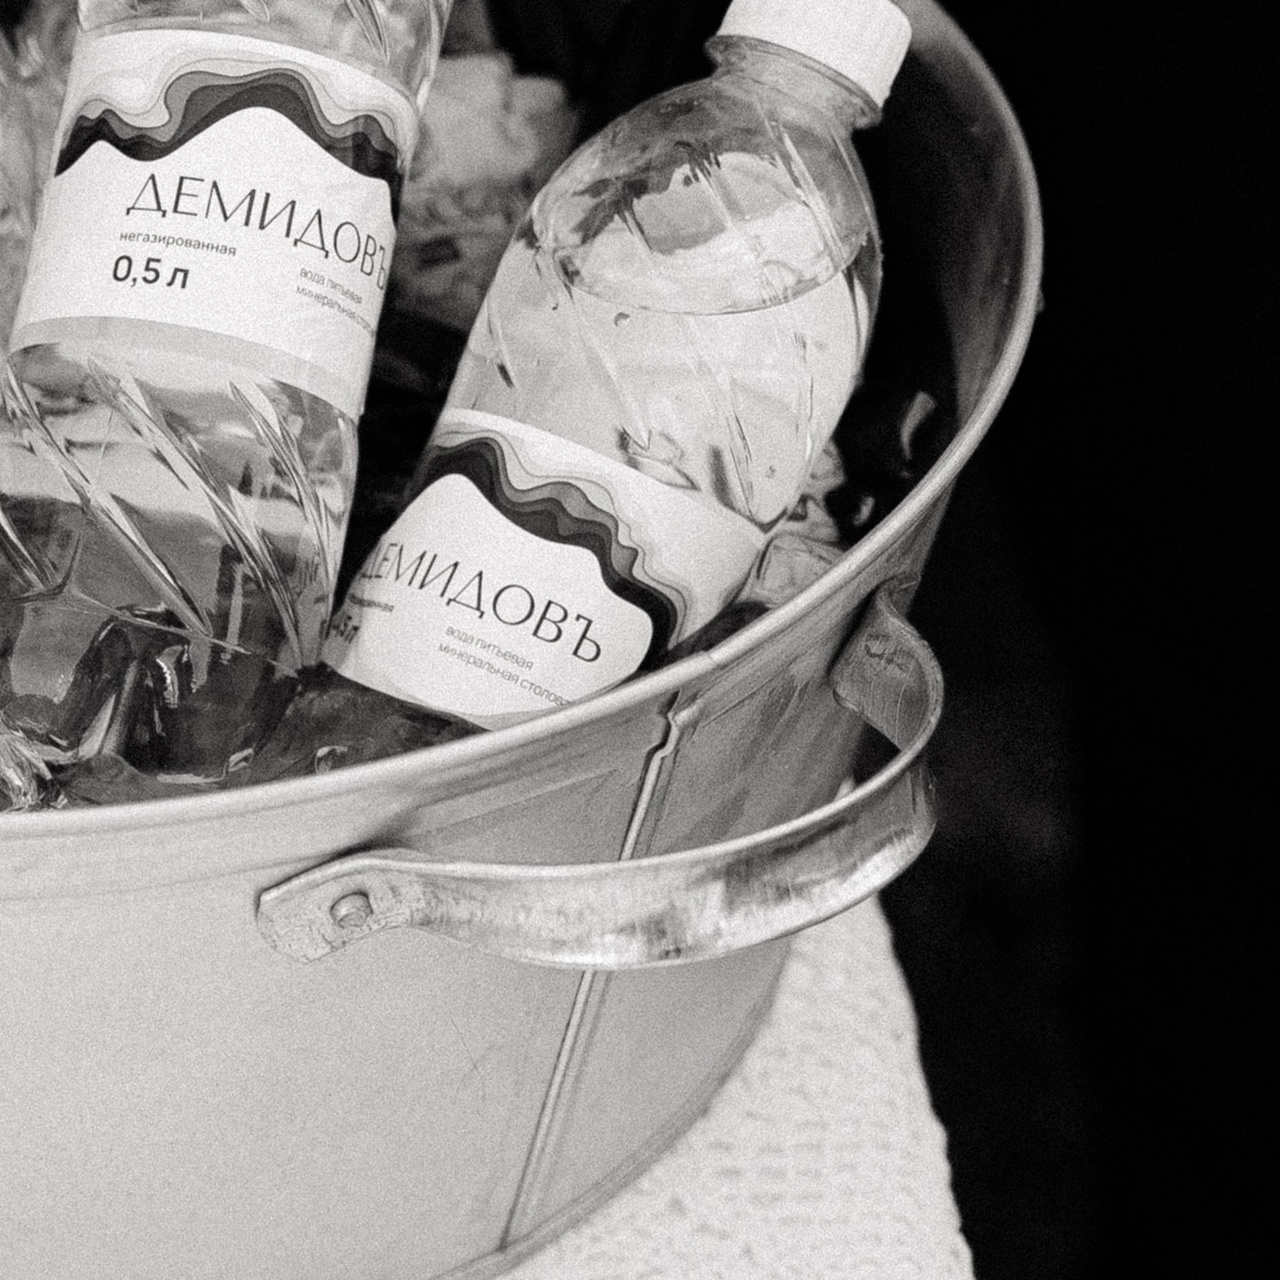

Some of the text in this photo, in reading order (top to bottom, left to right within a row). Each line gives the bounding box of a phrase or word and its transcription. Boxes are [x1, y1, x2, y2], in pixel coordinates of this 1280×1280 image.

[119, 231, 237, 257] негазированная
[125, 173, 387, 291] ДЕМИДОВЪ
[112, 255, 190, 289] 0,5 л
[438, 642, 519, 686] минеральная
[445, 625, 534, 672] вода питьевая
